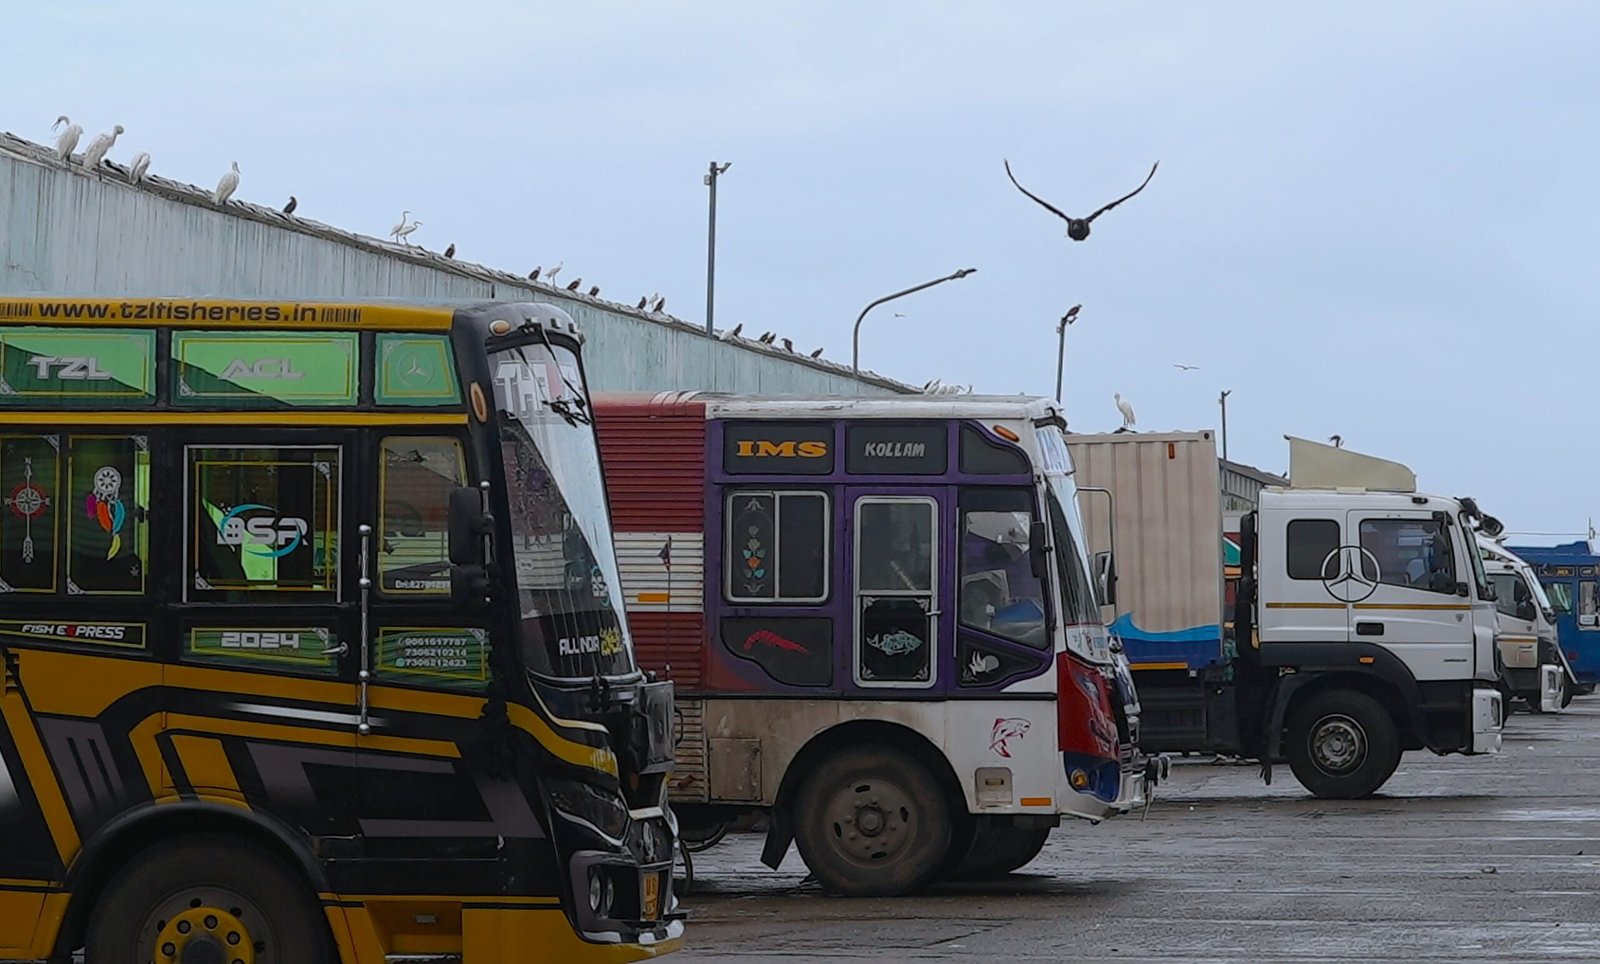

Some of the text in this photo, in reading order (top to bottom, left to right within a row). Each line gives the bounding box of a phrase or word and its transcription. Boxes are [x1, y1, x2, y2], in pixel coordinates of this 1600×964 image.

[26, 355, 112, 380] TZL
[219, 357, 304, 379] ACL
[737, 440, 828, 458] IMS
[864, 442, 925, 458] KOLLAM
[21, 624, 55, 635] FISH
[221, 631, 300, 649] 2024
